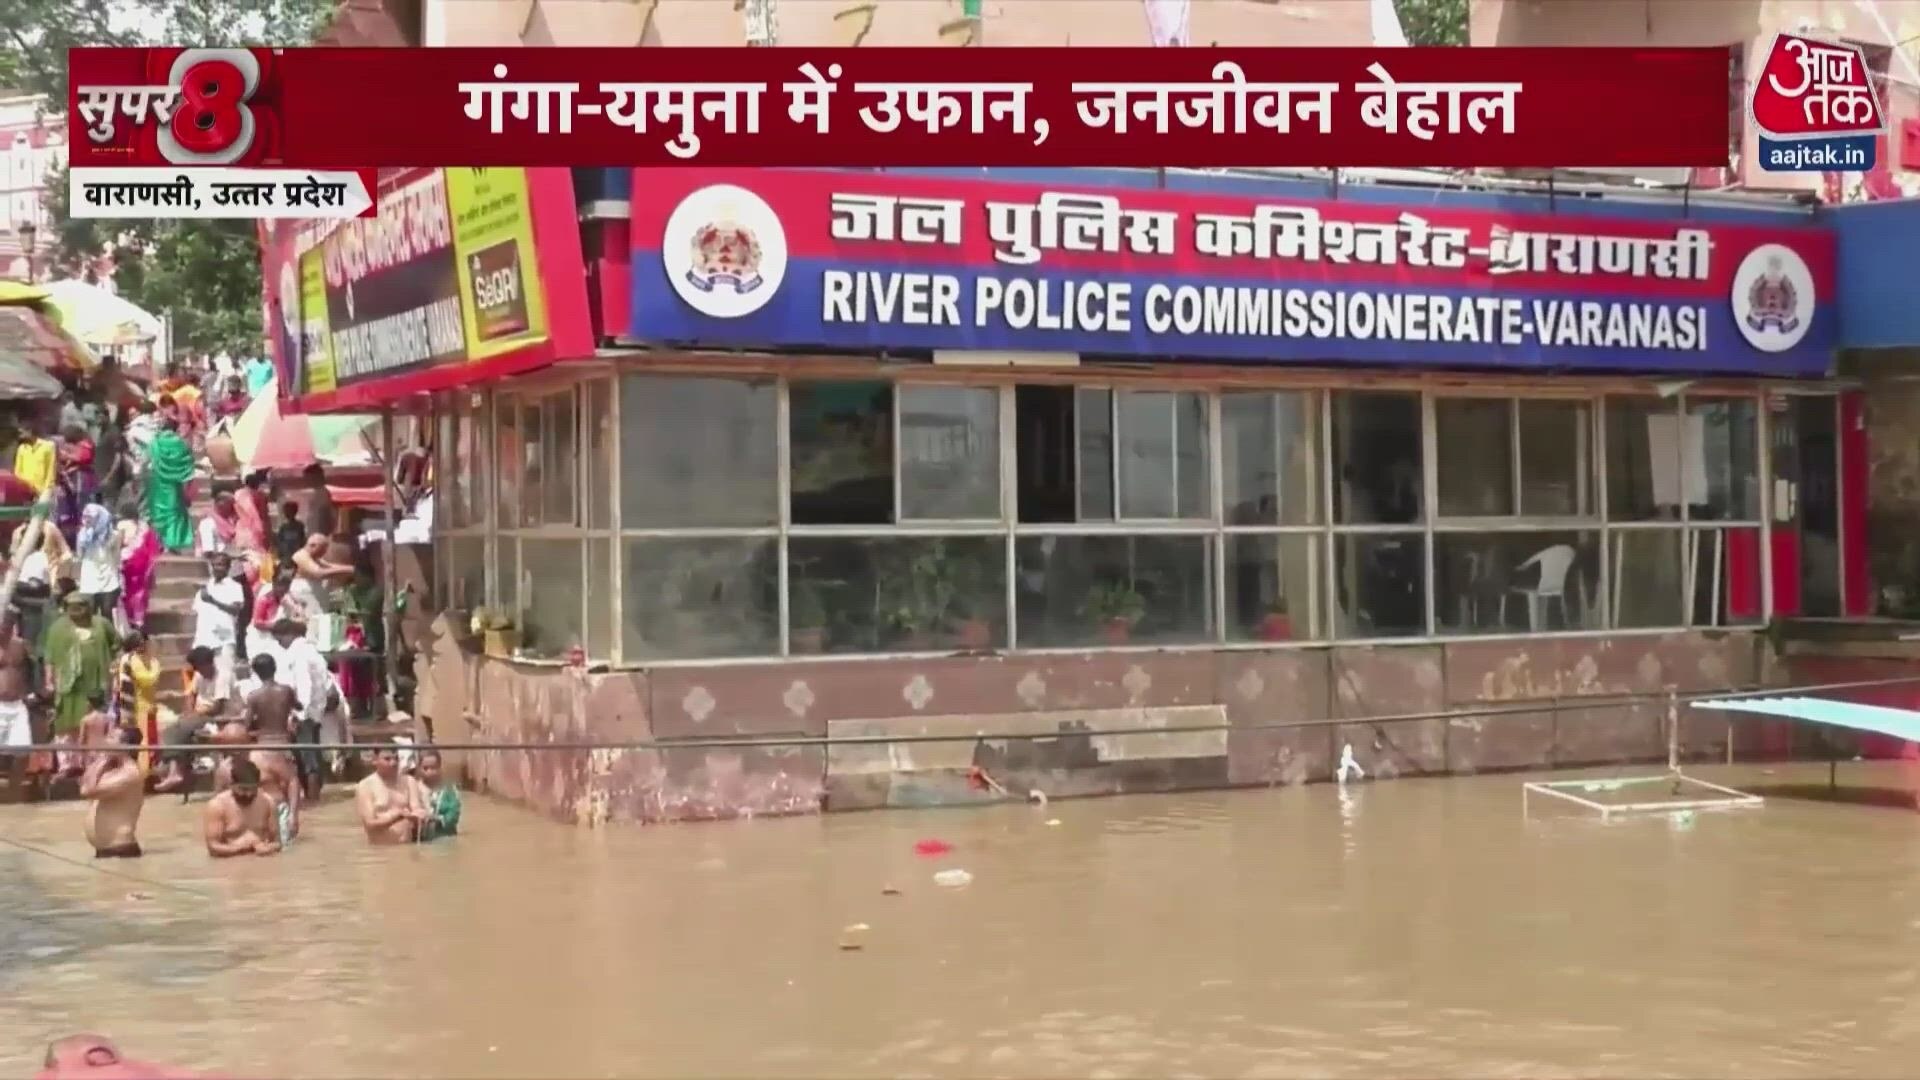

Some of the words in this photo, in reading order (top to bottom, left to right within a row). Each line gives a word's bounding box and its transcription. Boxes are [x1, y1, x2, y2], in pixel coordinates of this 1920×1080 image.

[832, 192, 965, 244] जल
[985, 191, 1178, 264] पुलिस
[823, 271, 961, 327] RIVER
[975, 276, 1131, 333] POLICE
[1145, 284, 1707, 351] COMMISSIONERATE-VARANASI
